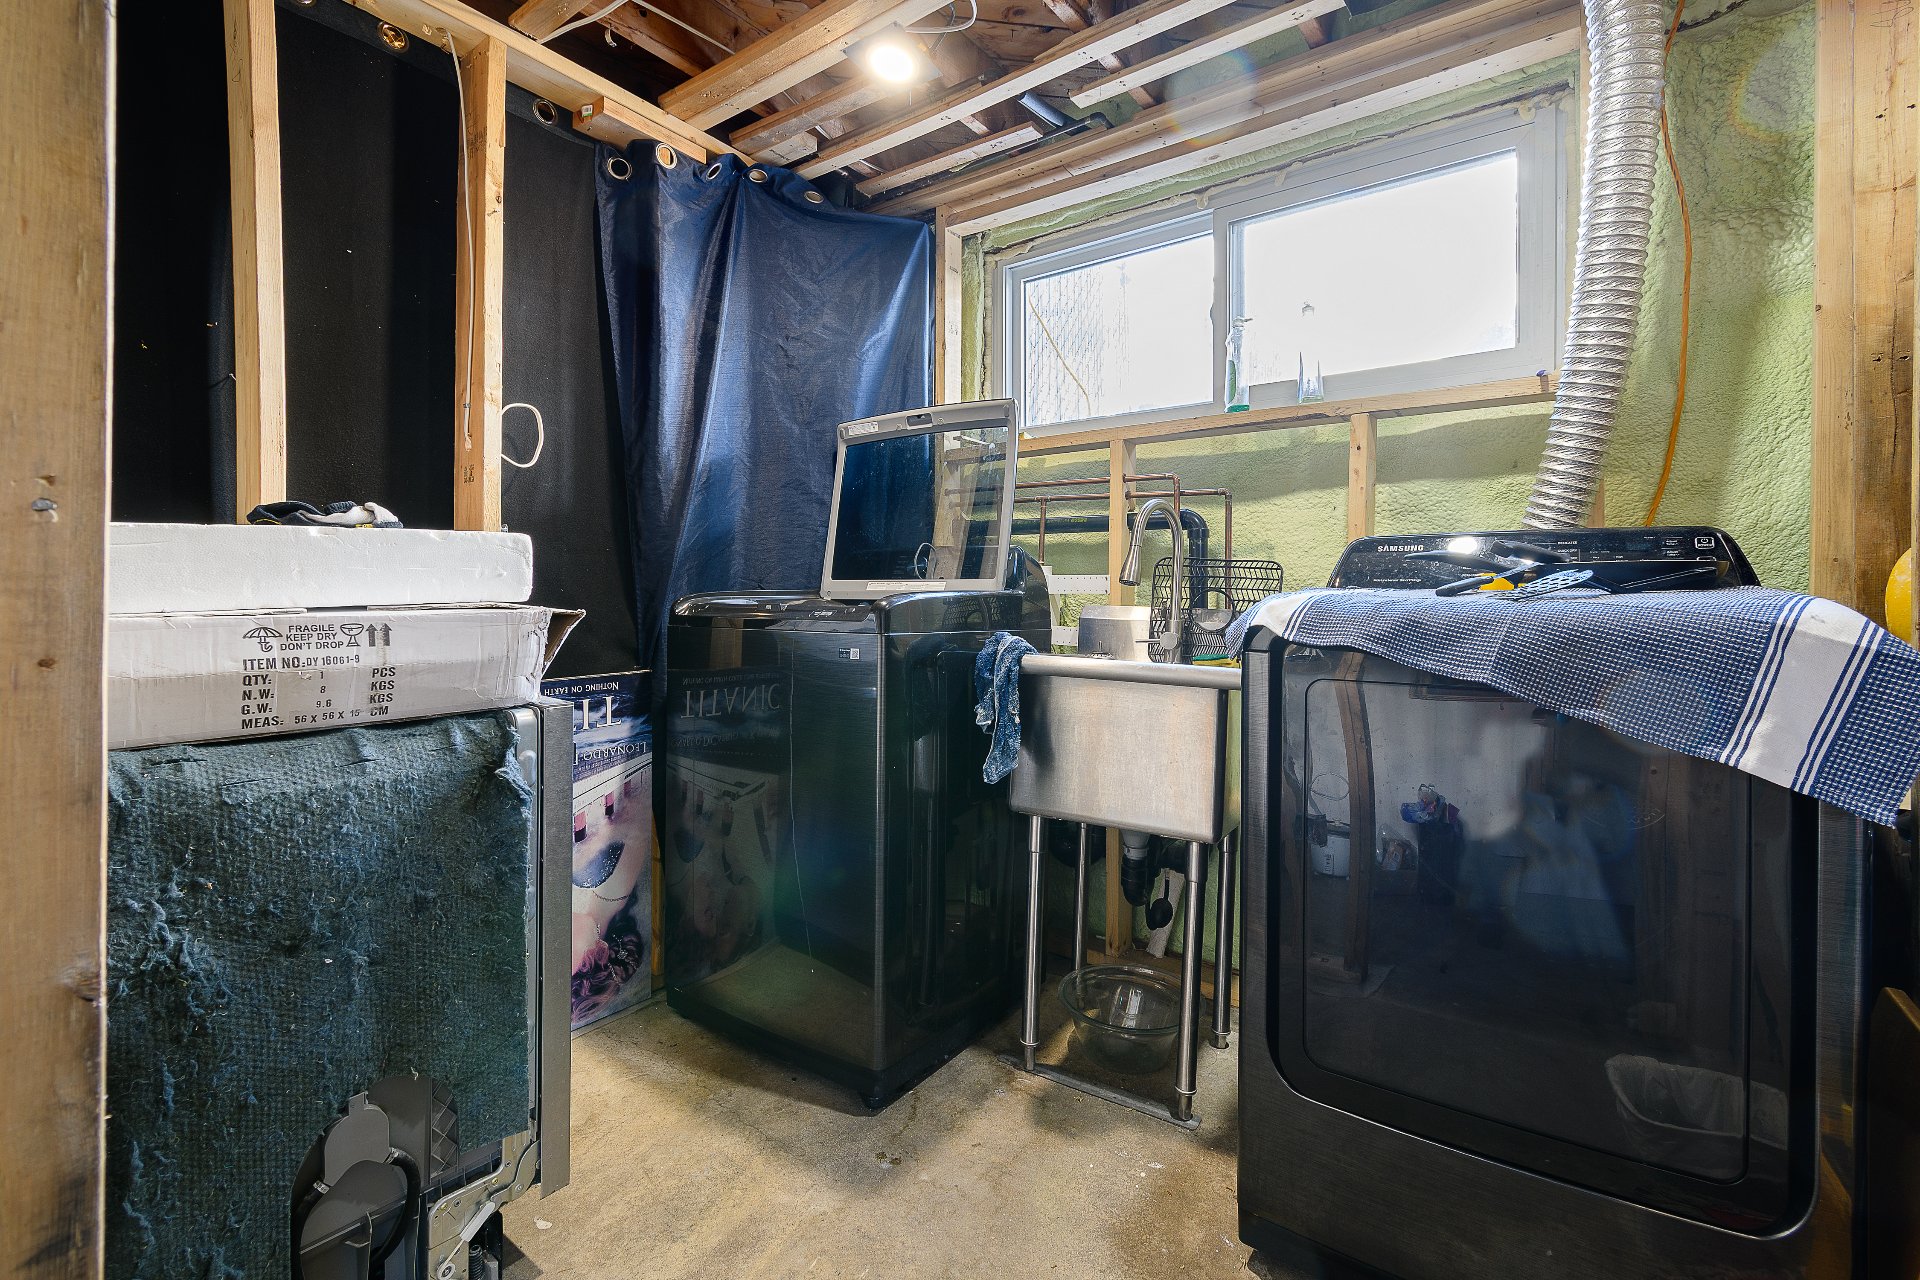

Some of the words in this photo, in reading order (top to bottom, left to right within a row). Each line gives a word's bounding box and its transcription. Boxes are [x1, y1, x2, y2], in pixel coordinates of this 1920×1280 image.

[1377, 544, 1424, 553] SAMSUNG
[288, 624, 335, 633] FRAGILE
[286, 633, 313, 642] KEEP
[317, 632, 338, 641] DRY
[280, 642, 312, 651] DON'T
[315, 640, 344, 650] DROP
[242, 658, 278, 671] ITEM
[242, 674, 272, 687] QTY:
[371, 666, 396, 679] PCS
[320, 685, 326, 694] 8
[370, 680, 395, 692] KGS
[544, 686, 569, 696] EARTH
[571, 685, 583, 693] ON
[585, 682, 619, 691] NOTHING
[316, 699, 332, 708] 9.6
[369, 693, 394, 705] KGS
[241, 715, 284, 730] MEAS:
[294, 715, 308, 725] 56
[322, 711, 335, 721] 56
[369, 705, 389, 717] CM
[583, 741, 647, 761] LEONARDO
